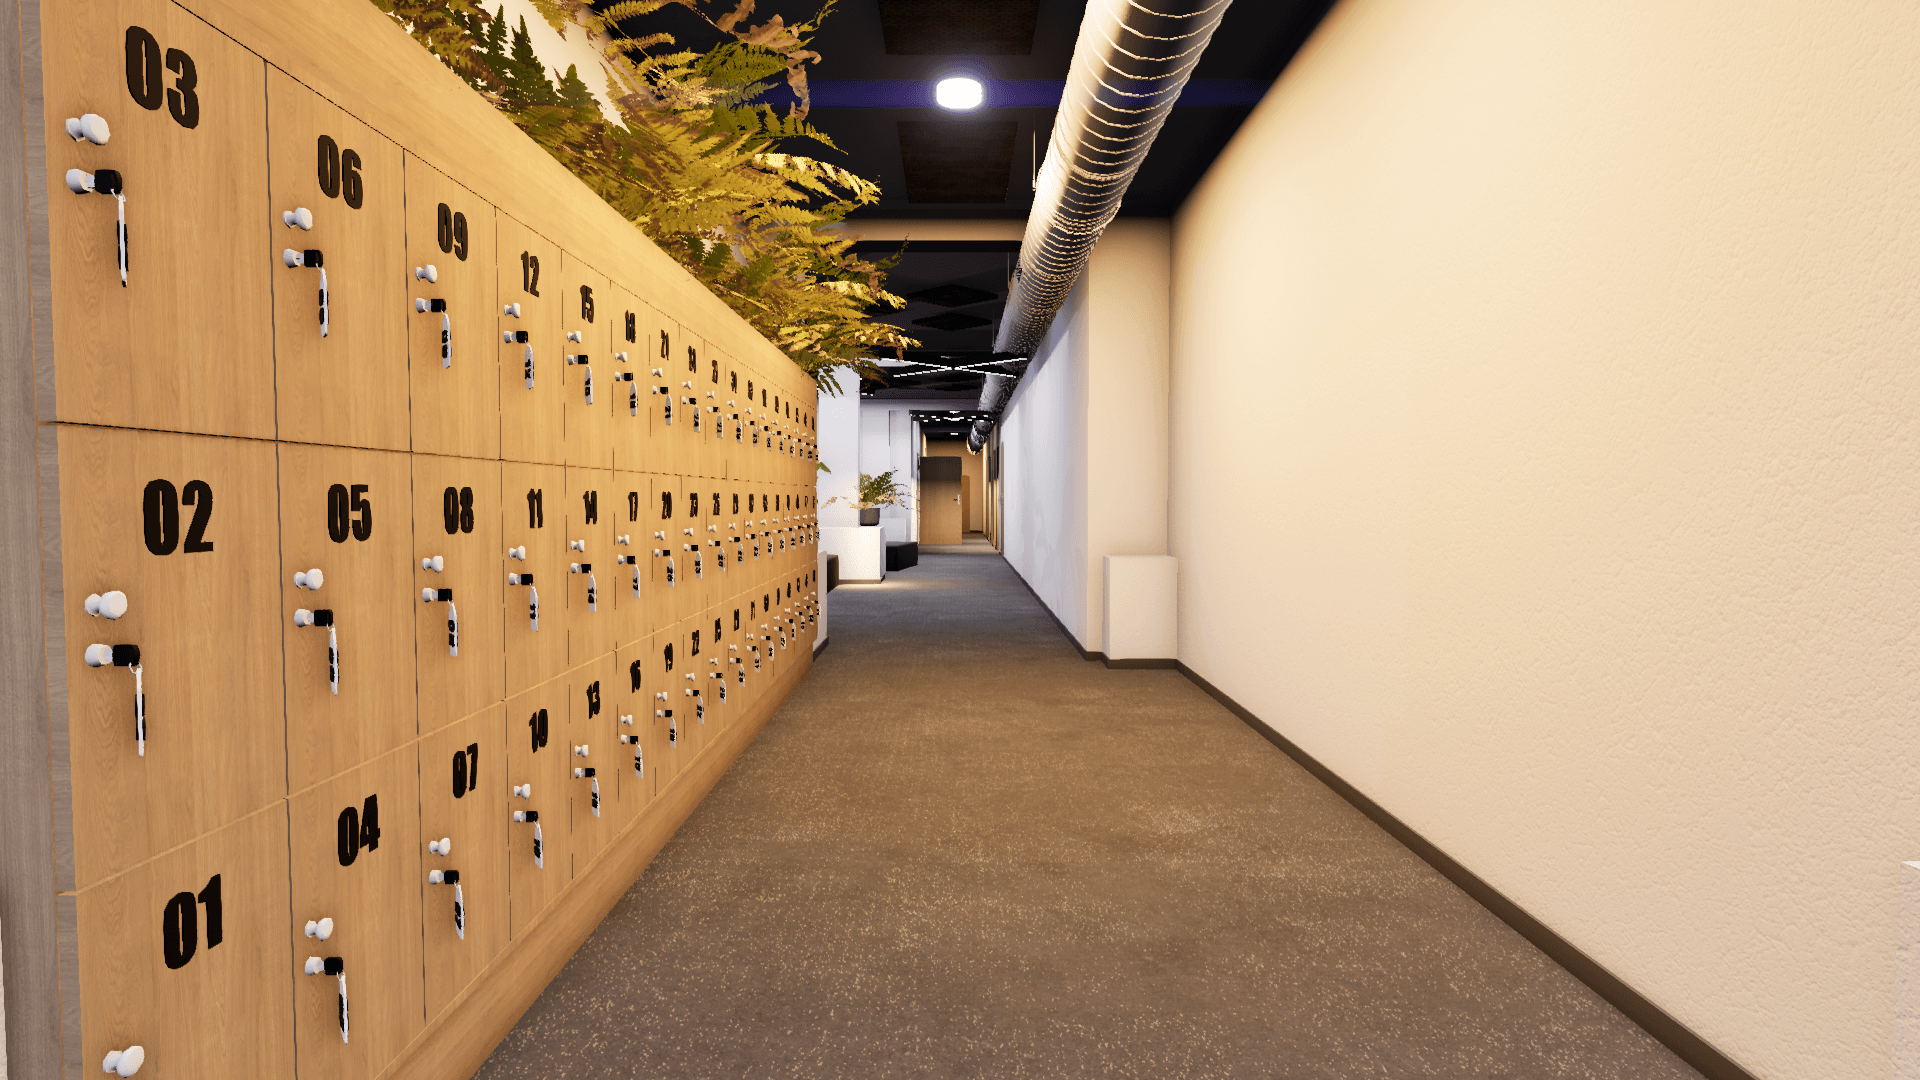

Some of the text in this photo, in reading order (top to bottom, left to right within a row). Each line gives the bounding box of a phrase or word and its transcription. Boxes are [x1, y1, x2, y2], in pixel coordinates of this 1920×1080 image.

[125, 26, 199, 129] 03
[318, 135, 363, 209] 06
[438, 203, 468, 261] 09
[521, 251, 539, 297] 12
[580, 285, 594, 323] 15
[661, 330, 669, 360] 21
[143, 479, 213, 555] 02
[328, 484, 372, 543] 05
[444, 487, 474, 534] 08
[527, 488, 543, 528] 11
[583, 491, 597, 524] 14
[628, 492, 638, 521] 17
[630, 660, 641, 693] 16
[586, 681, 600, 719] 13
[529, 709, 548, 753] 10
[453, 743, 478, 798] 07
[338, 794, 380, 866] 04
[163, 874, 223, 969] 01
